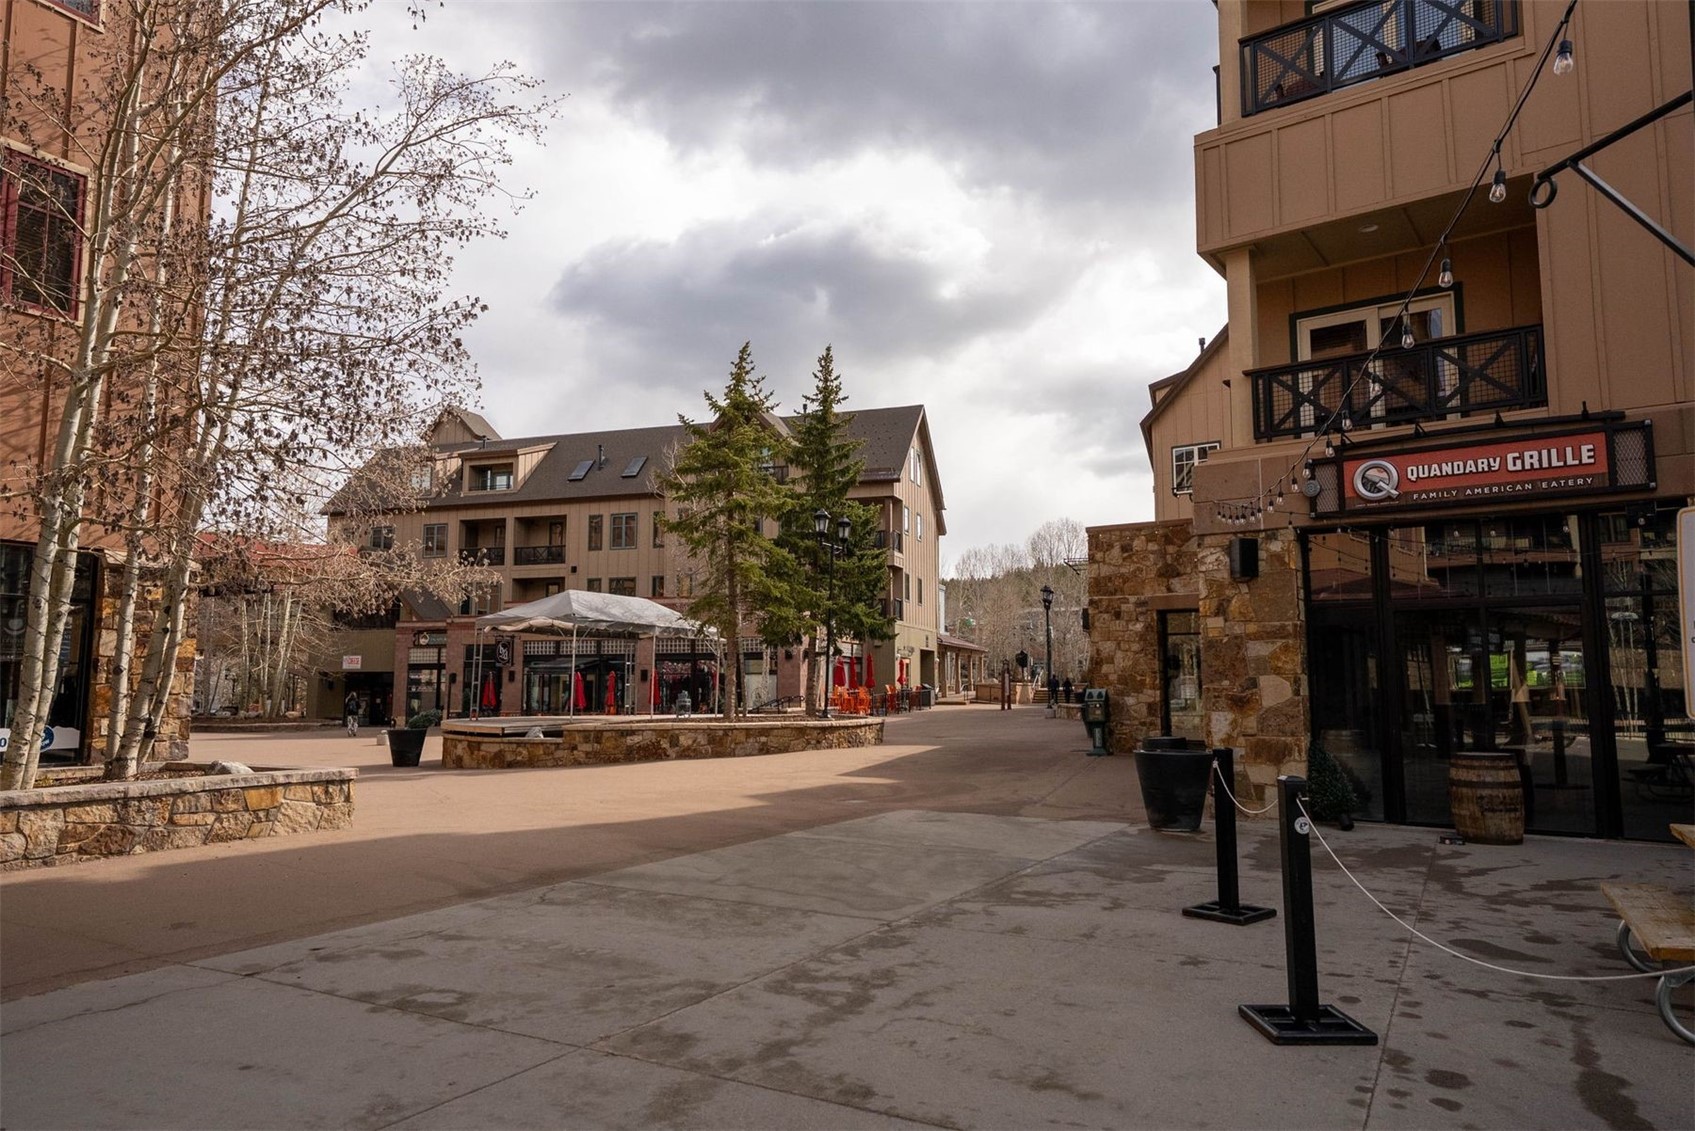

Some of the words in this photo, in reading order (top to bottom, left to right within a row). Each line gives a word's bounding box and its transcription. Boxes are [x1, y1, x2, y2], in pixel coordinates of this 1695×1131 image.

[1407, 457, 1501, 482] QUANDARY
[1506, 444, 1595, 472] GRILLE
[1413, 490, 1457, 500] FAMILY
[1465, 483, 1532, 496] AMERICAN
[1542, 477, 1593, 489] EATERY
